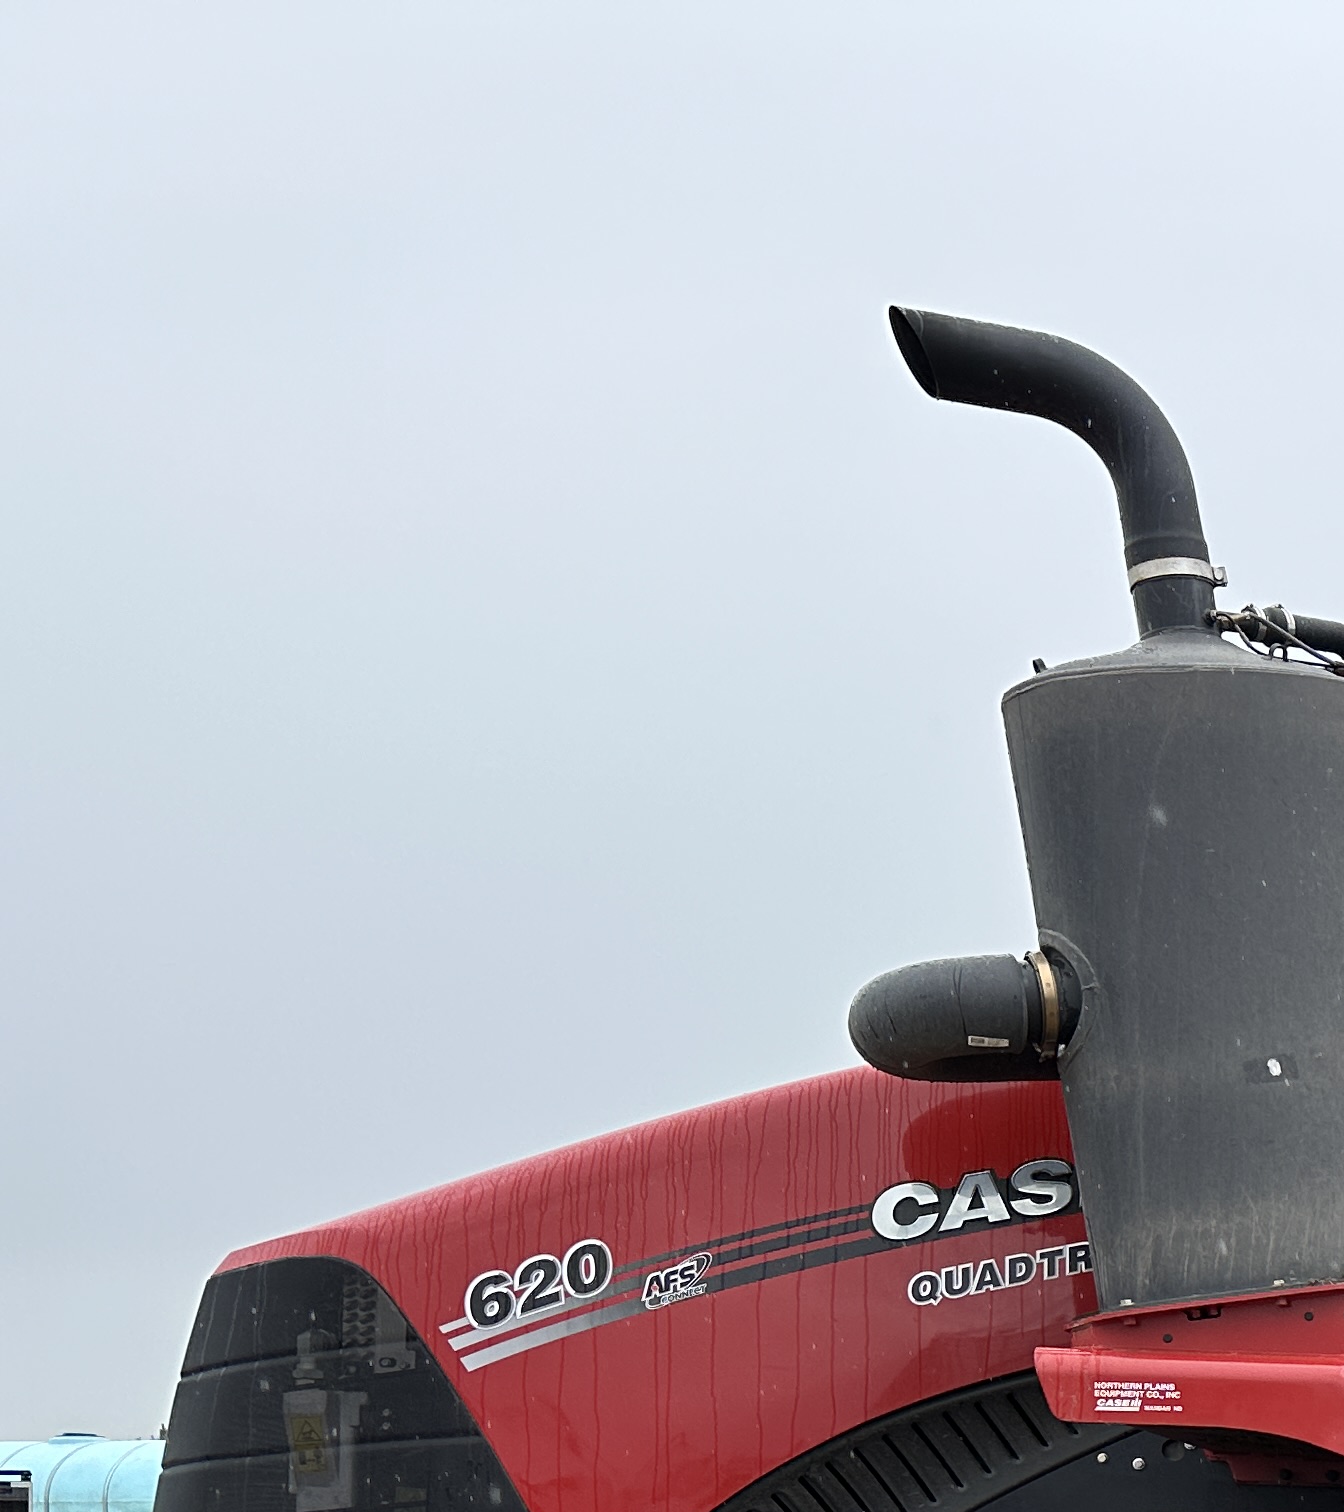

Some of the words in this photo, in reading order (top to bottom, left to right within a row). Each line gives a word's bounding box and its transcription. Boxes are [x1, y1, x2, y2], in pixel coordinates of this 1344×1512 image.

[872, 1159, 1083, 1240] CAS
[465, 1239, 613, 1330] 620
[643, 1261, 698, 1300] AFS
[908, 1242, 1094, 1306] QUADTR
[661, 1284, 707, 1304] CONNECT
[1093, 1390, 1145, 1398] EQUIPMENT
[1166, 1391, 1181, 1399] INC
[1094, 1382, 1142, 1390] NORTHERN
[1144, 1383, 1175, 1391] PLAINS
